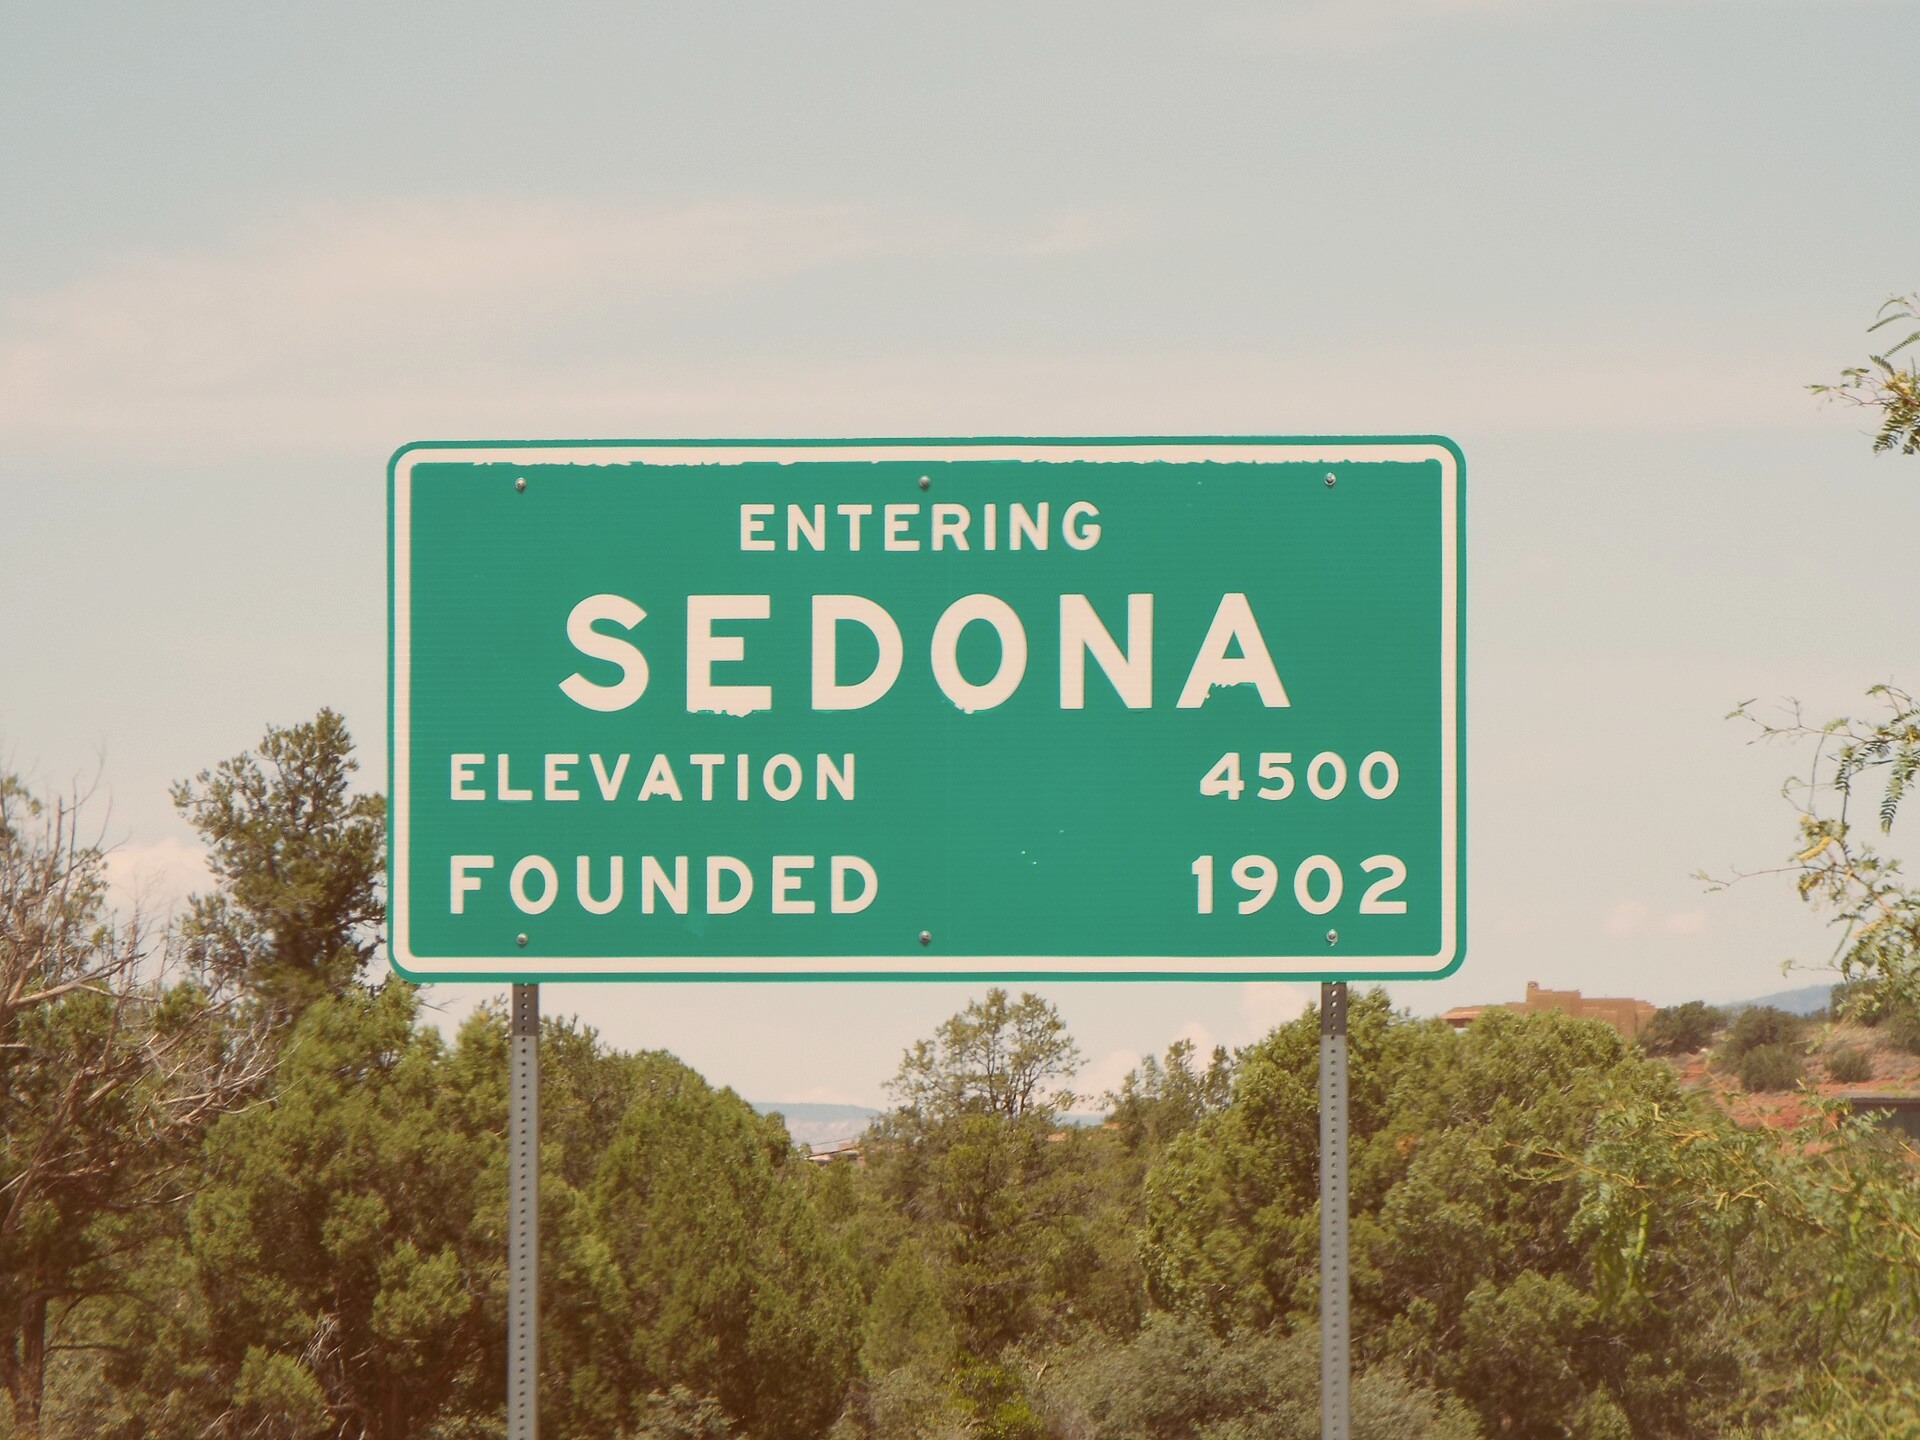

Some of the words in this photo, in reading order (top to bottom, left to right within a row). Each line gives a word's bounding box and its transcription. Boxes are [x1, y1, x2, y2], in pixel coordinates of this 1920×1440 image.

[740, 501, 1102, 552] ENTERING
[559, 593, 1290, 715] SEDONA
[451, 754, 855, 802] ELEVATION
[1200, 751, 1400, 801] 4500
[451, 855, 879, 915] FOUNDED
[1192, 855, 1408, 915] 1902
